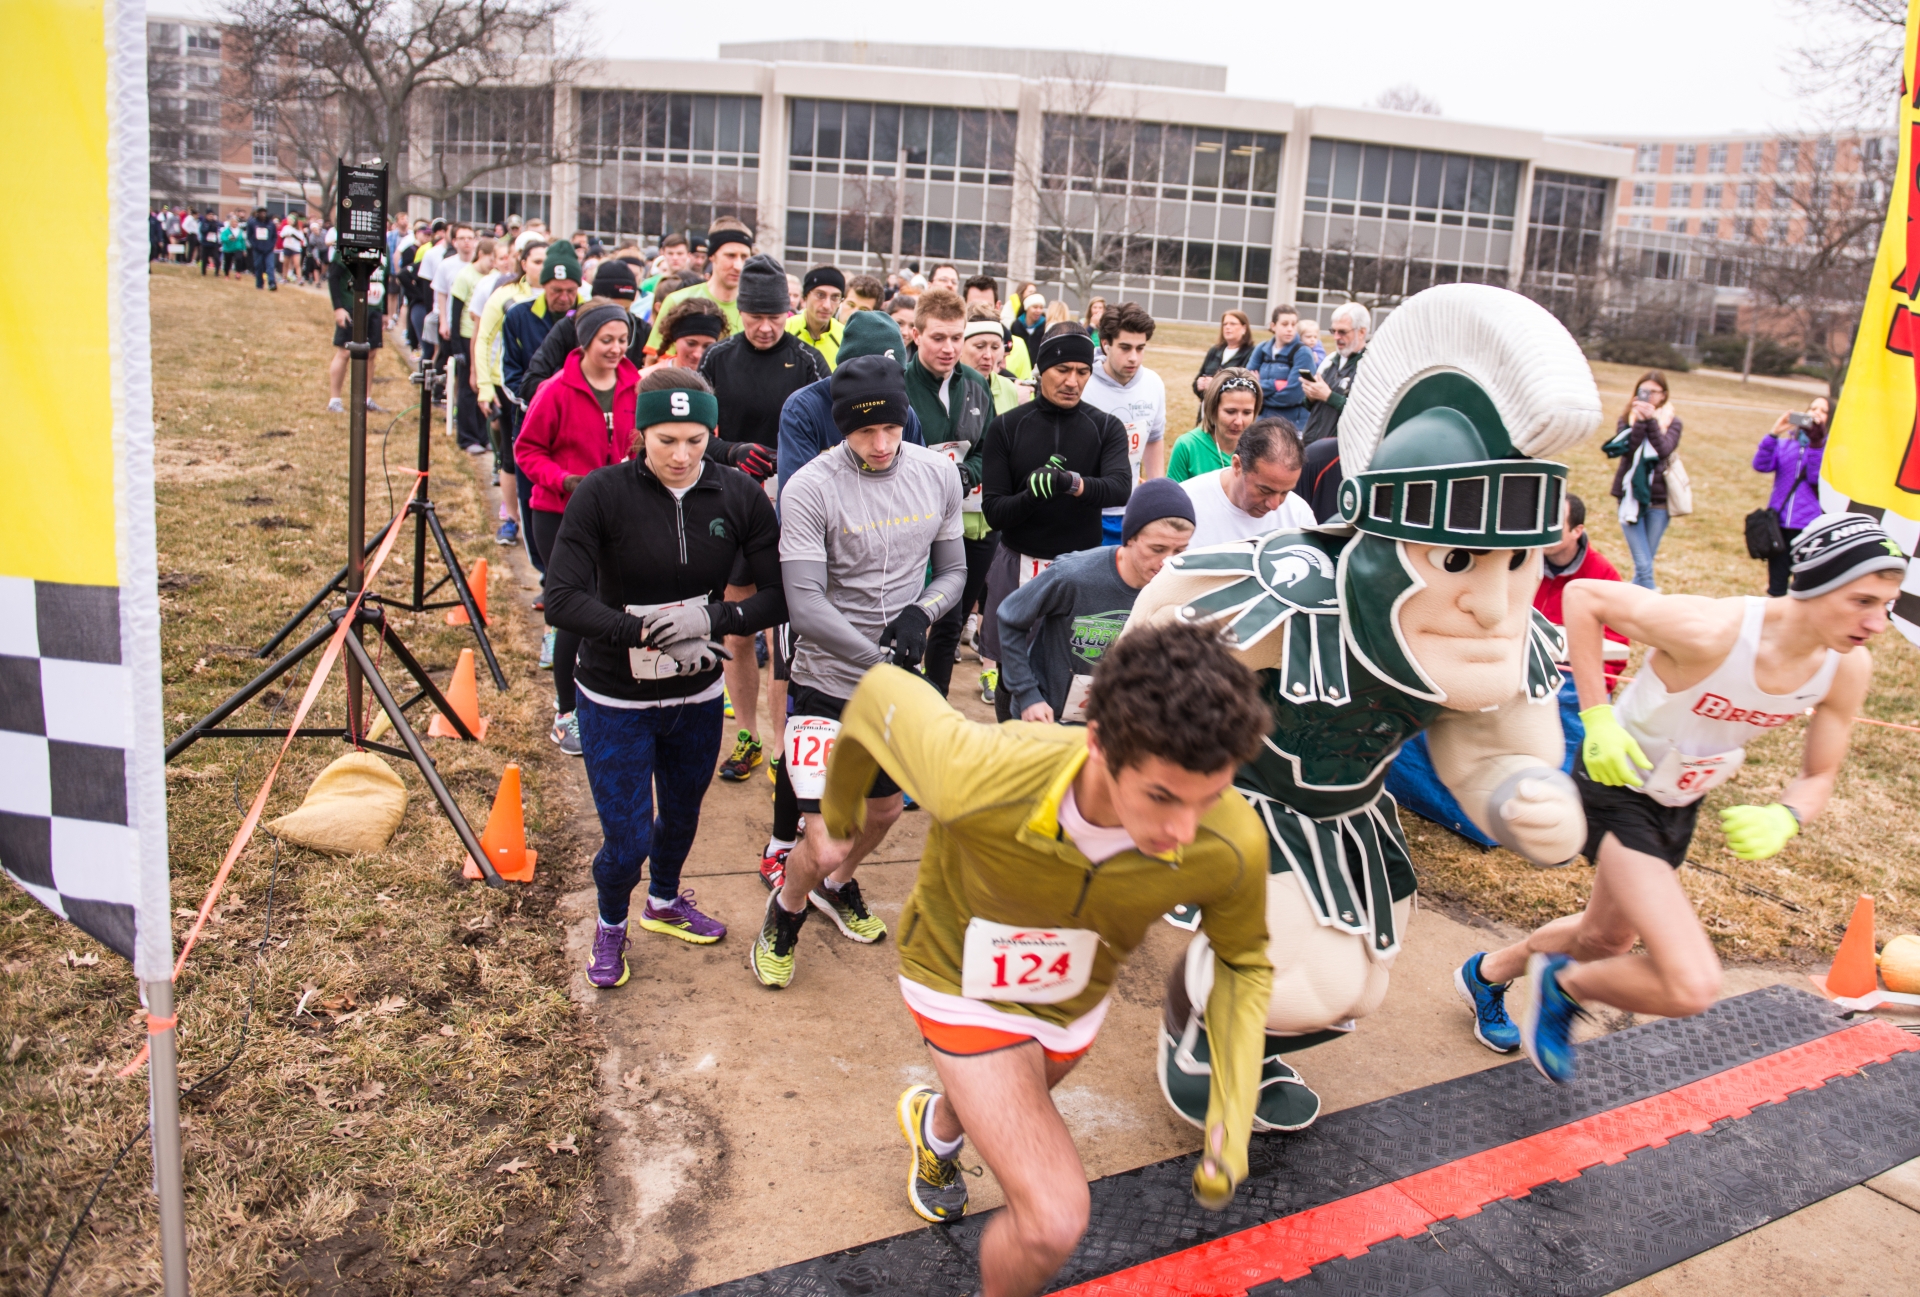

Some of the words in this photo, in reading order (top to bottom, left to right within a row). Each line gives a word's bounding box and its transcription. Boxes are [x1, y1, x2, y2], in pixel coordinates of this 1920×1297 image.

[553, 264, 567, 280] S
[670, 391, 691, 417] S
[851, 400, 886, 410] LIVESTRONG
[843, 513, 919, 535] LIVESTRONG
[793, 724, 836, 732] playmakers
[990, 951, 1072, 988] 124
